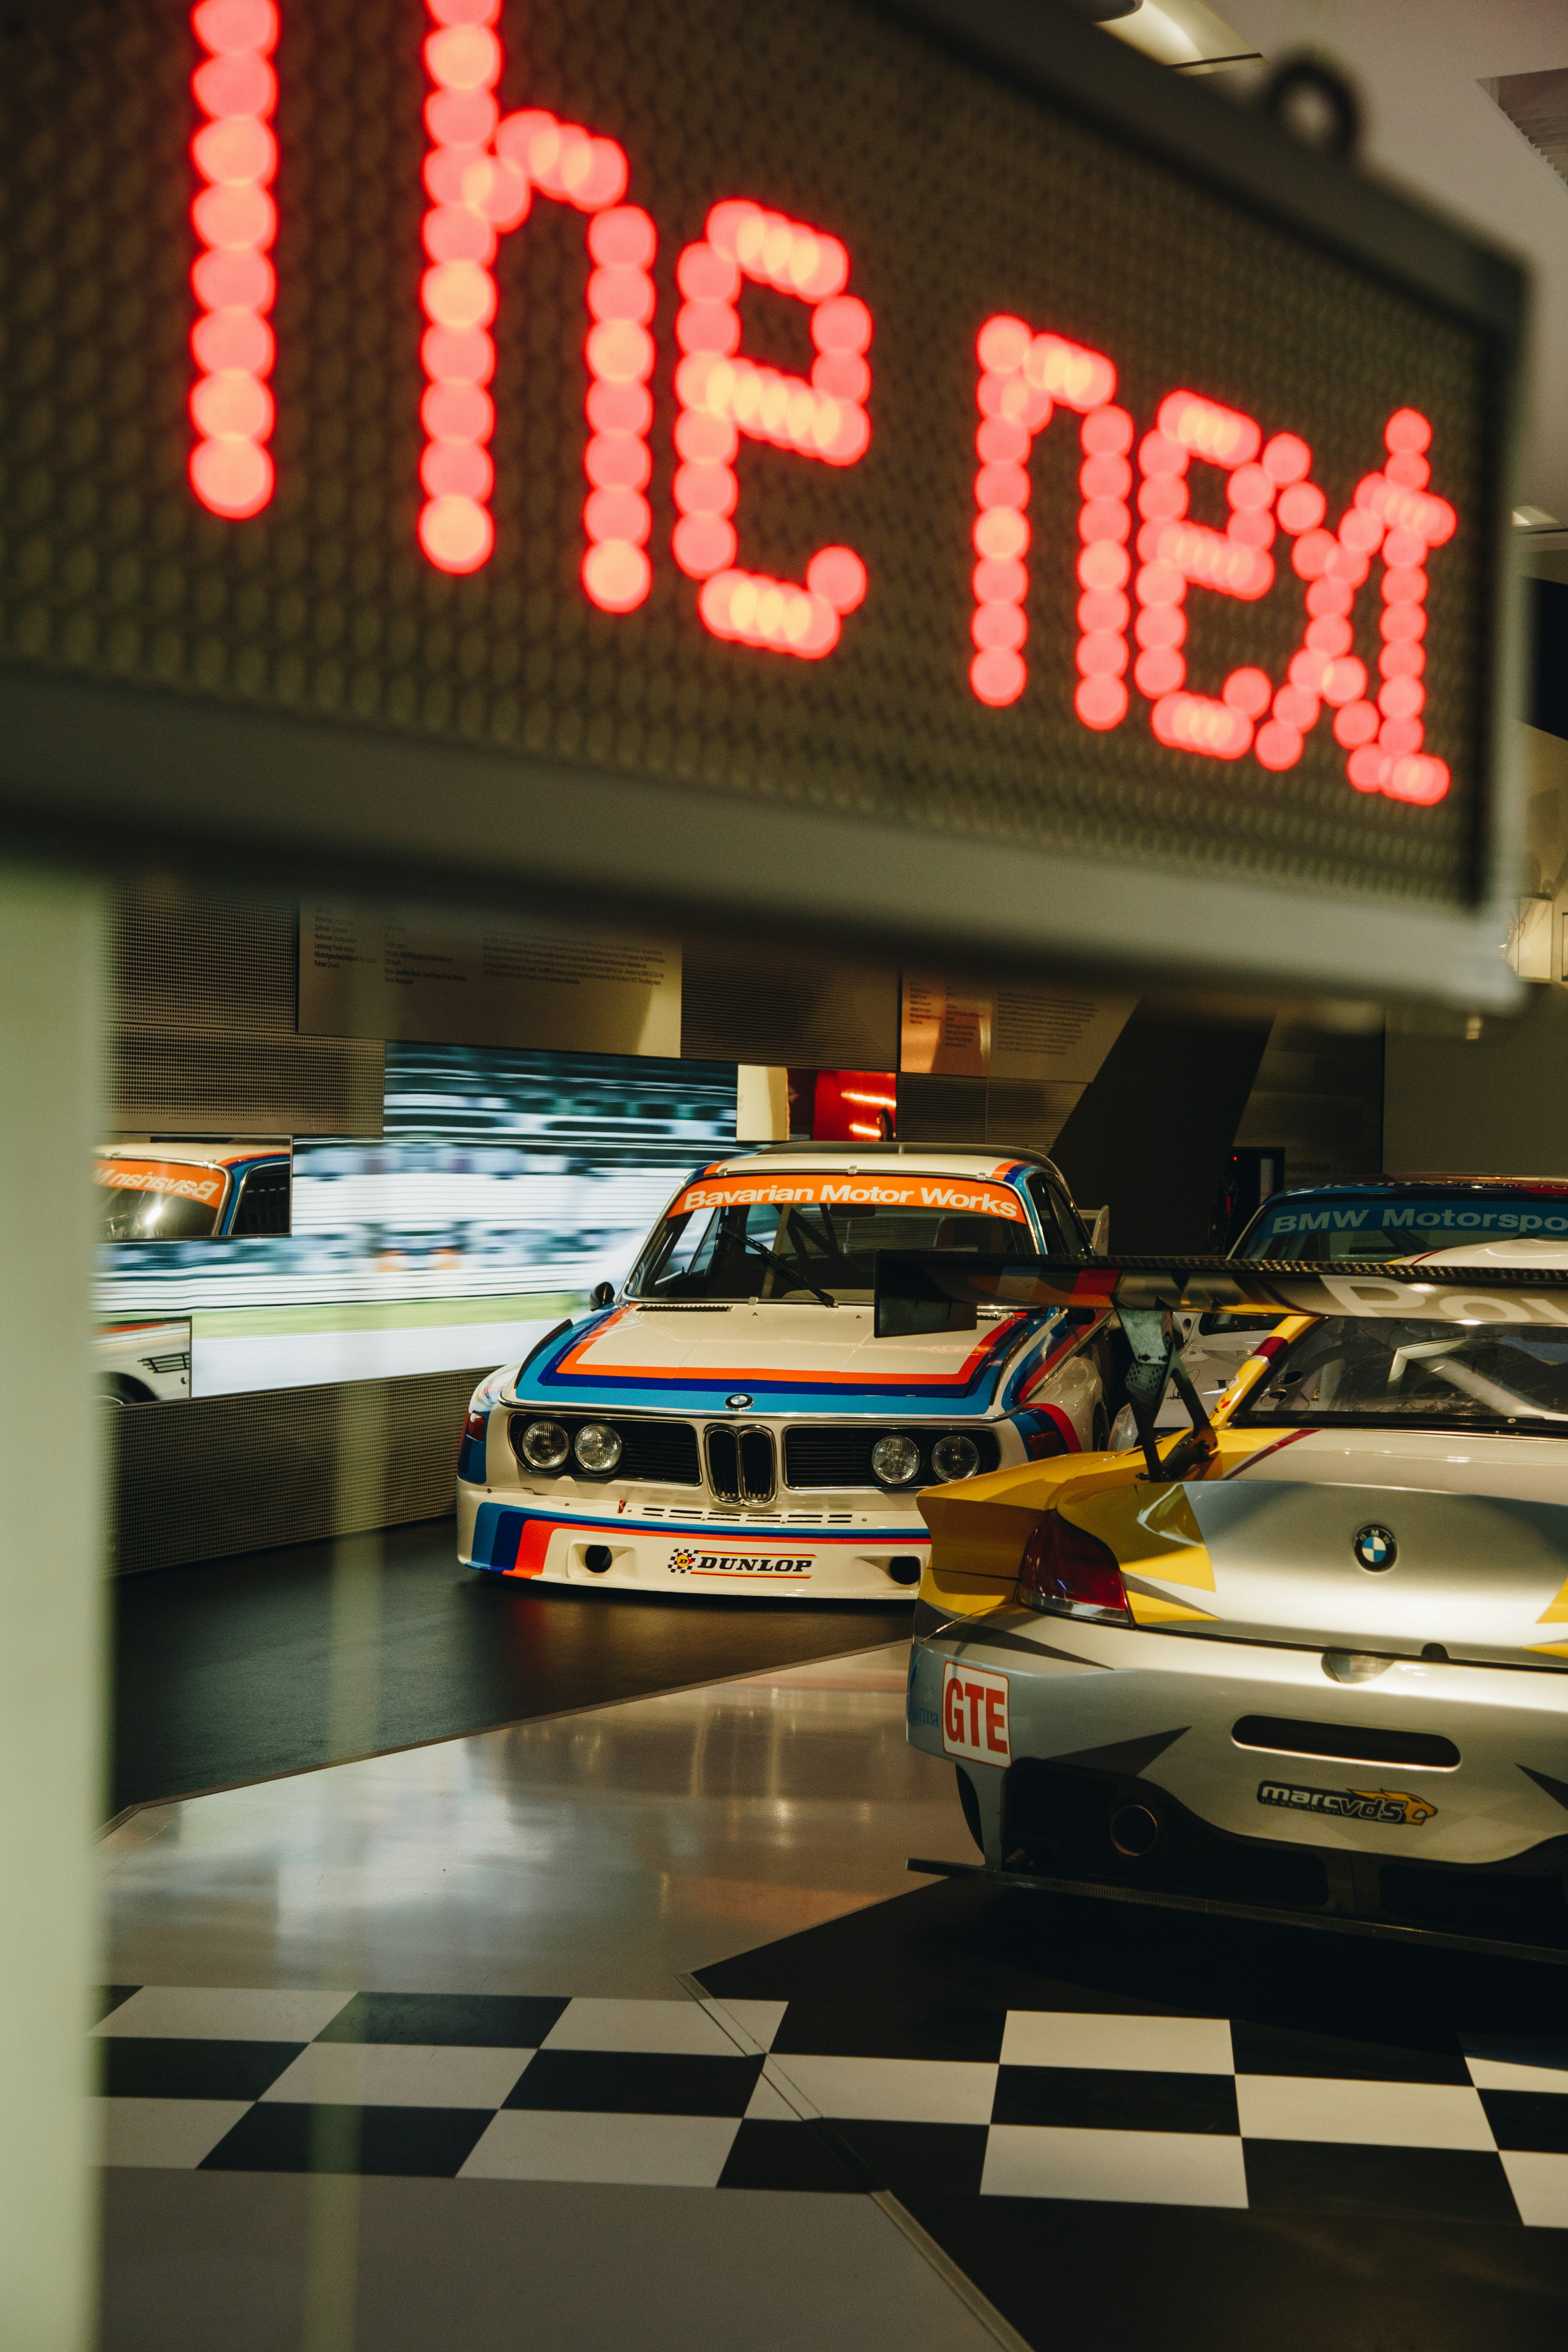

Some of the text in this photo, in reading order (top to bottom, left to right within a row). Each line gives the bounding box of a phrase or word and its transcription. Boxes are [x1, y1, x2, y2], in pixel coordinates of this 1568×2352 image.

[969, 313, 1457, 805] next
[684, 1183, 1017, 1218] Bavarian Motor Works
[1272, 1210, 1369, 1234] BMW
[697, 1556, 812, 1572] DUNLOP
[946, 1678, 1008, 1755] GTE
